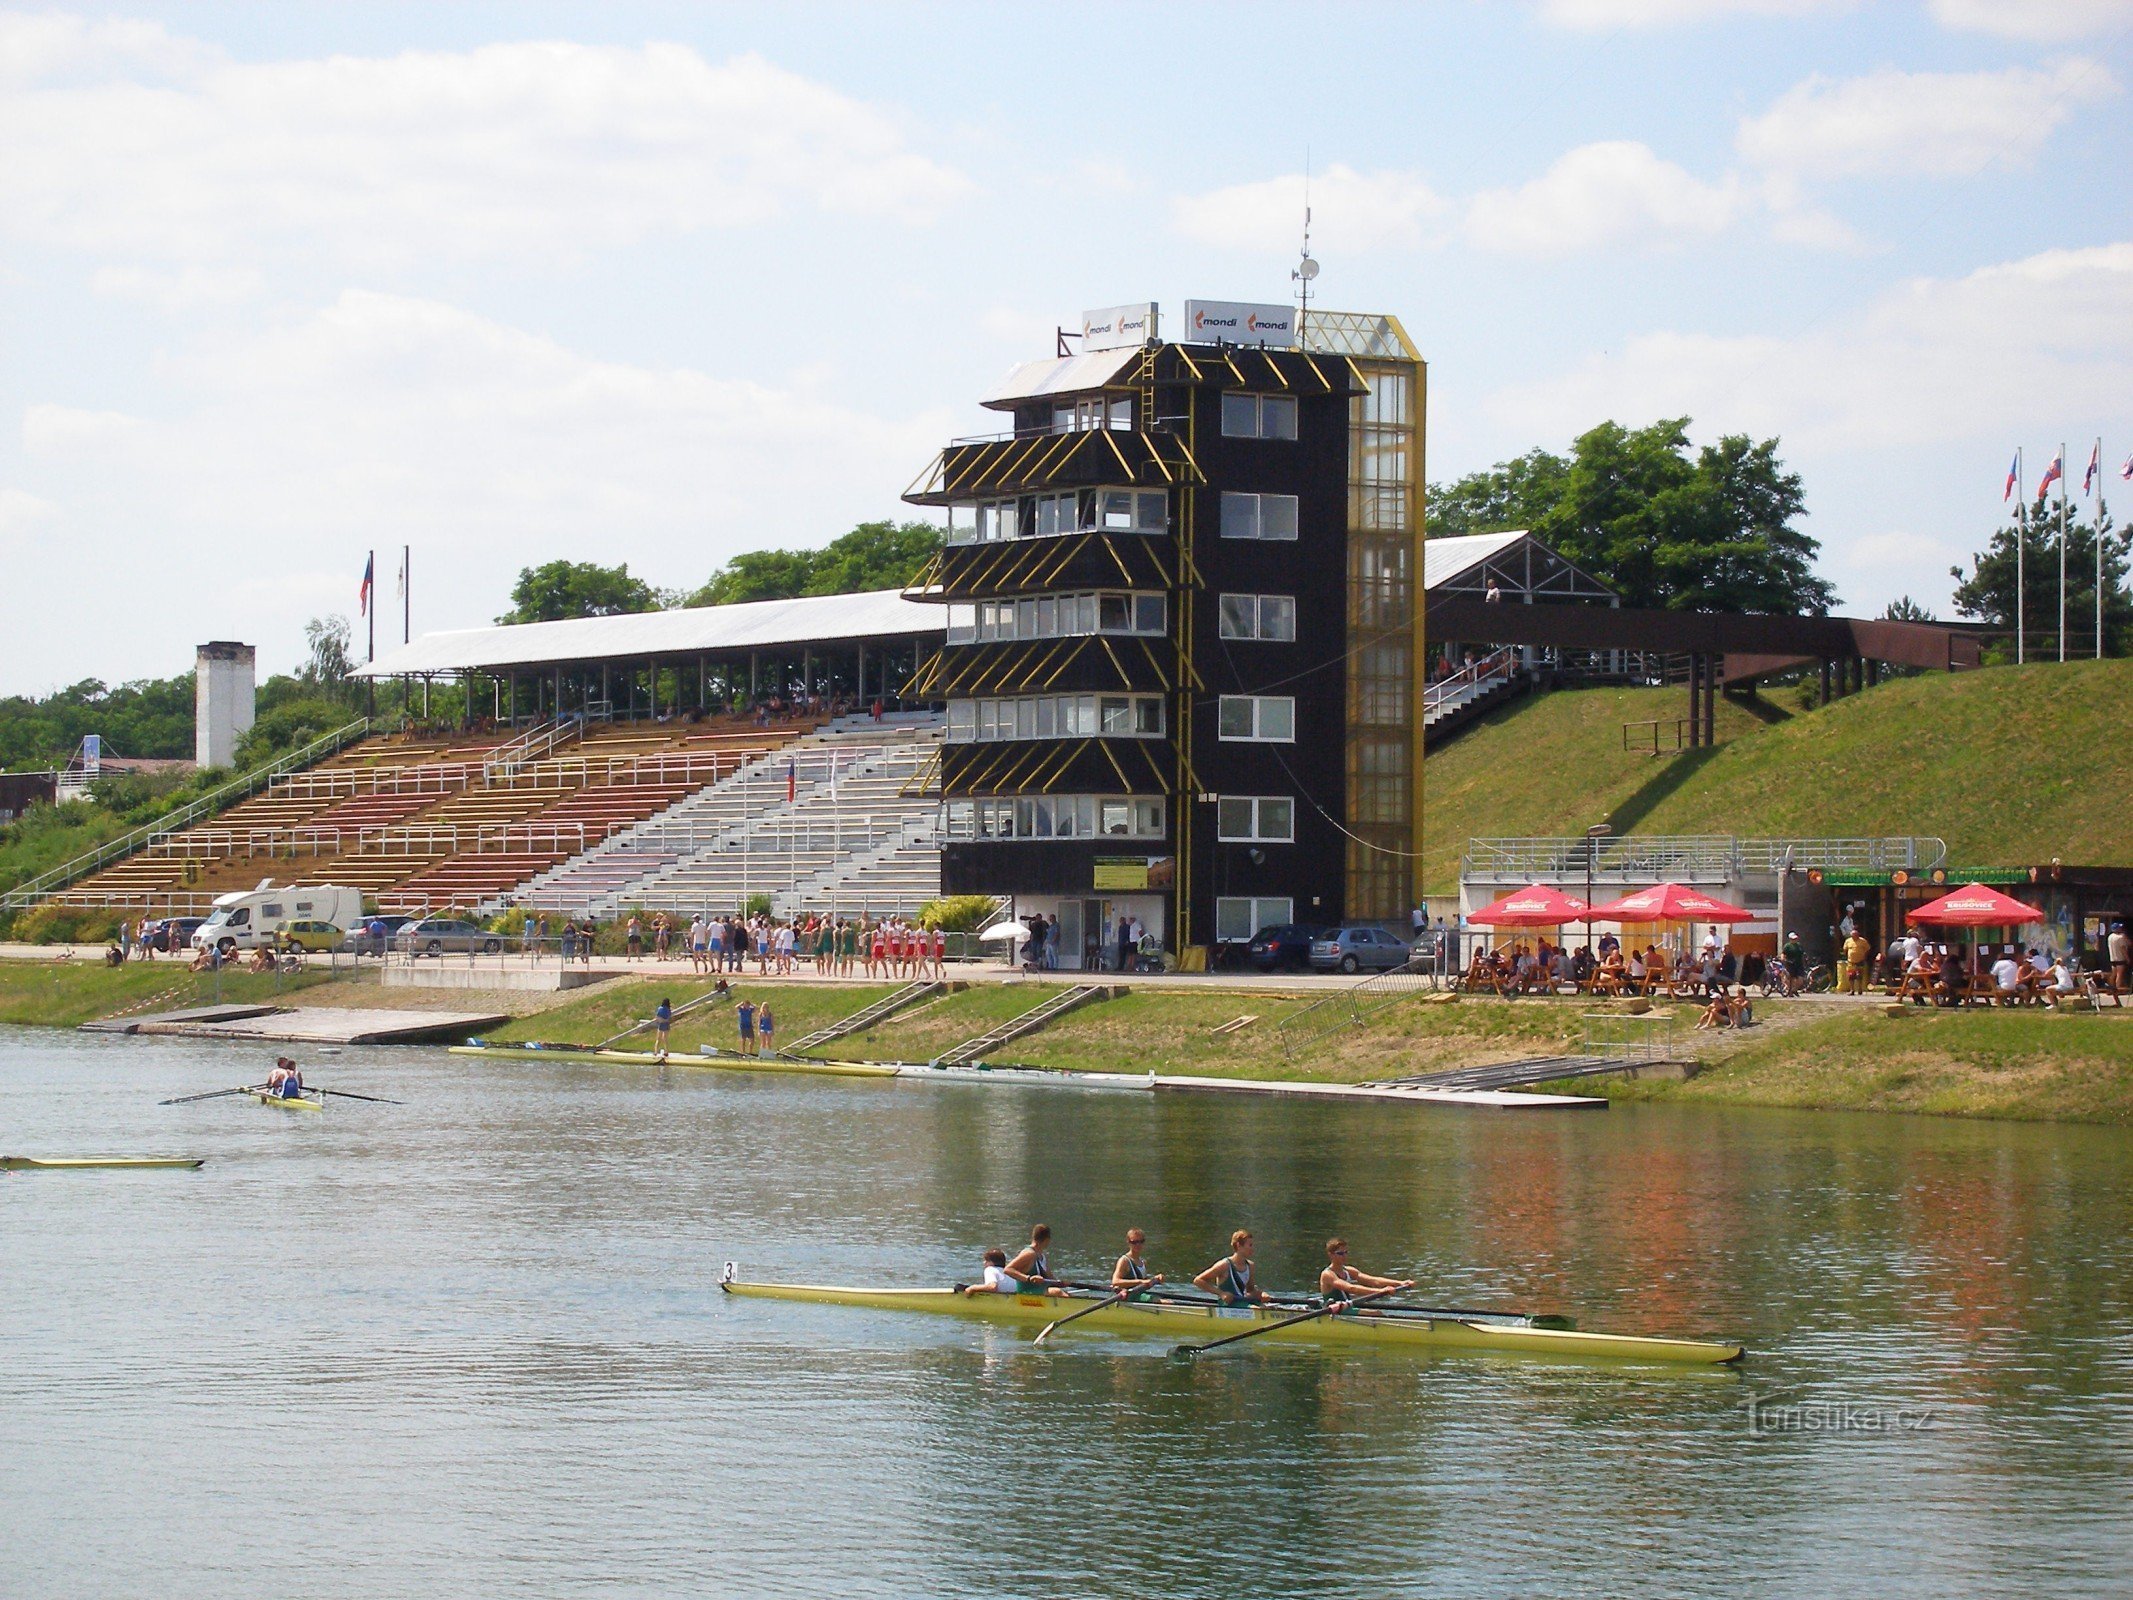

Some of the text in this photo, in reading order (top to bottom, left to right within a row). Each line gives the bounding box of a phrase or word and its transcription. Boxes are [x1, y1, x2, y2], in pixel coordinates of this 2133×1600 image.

[1123, 320, 1144, 330] mond
[1203, 318, 1237, 326] mondi
[1255, 321, 1288, 330] mondi
[1089, 323, 1111, 334] mondi
[726, 1262, 733, 1280] 3
